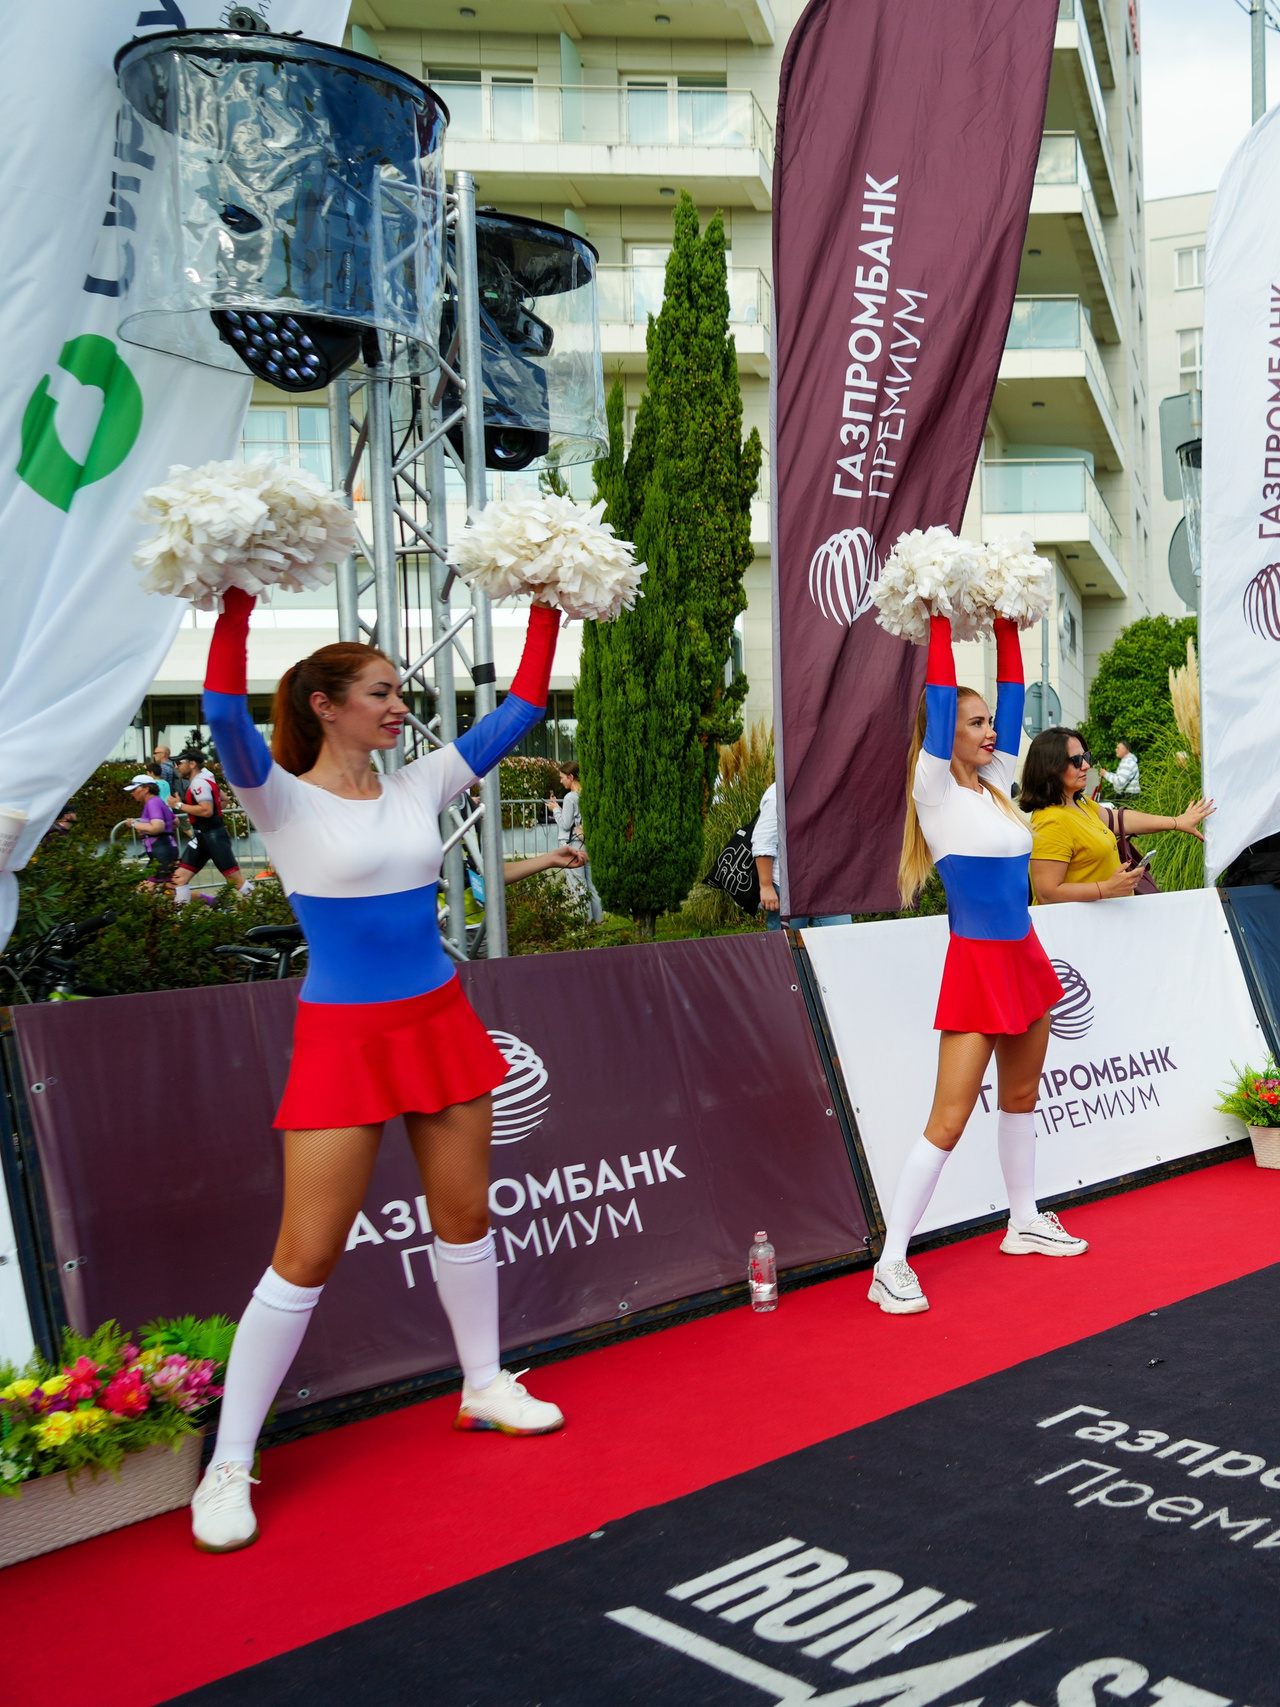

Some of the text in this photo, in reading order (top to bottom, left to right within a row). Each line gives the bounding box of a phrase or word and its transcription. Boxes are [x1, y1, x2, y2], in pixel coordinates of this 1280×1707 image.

[832, 172, 900, 499] ГАЗПРОМБАНК
[868, 288, 929, 499] ПРЕМИУМ
[979, 1046, 1178, 1113] ГПРОМБАНК
[1034, 1083, 1160, 1138] ПРЕМИУМ
[344, 1145, 686, 1252] АЗОМБАНК
[400, 1198, 644, 1289] ПМИУМ
[665, 1537, 978, 1674] IRON
